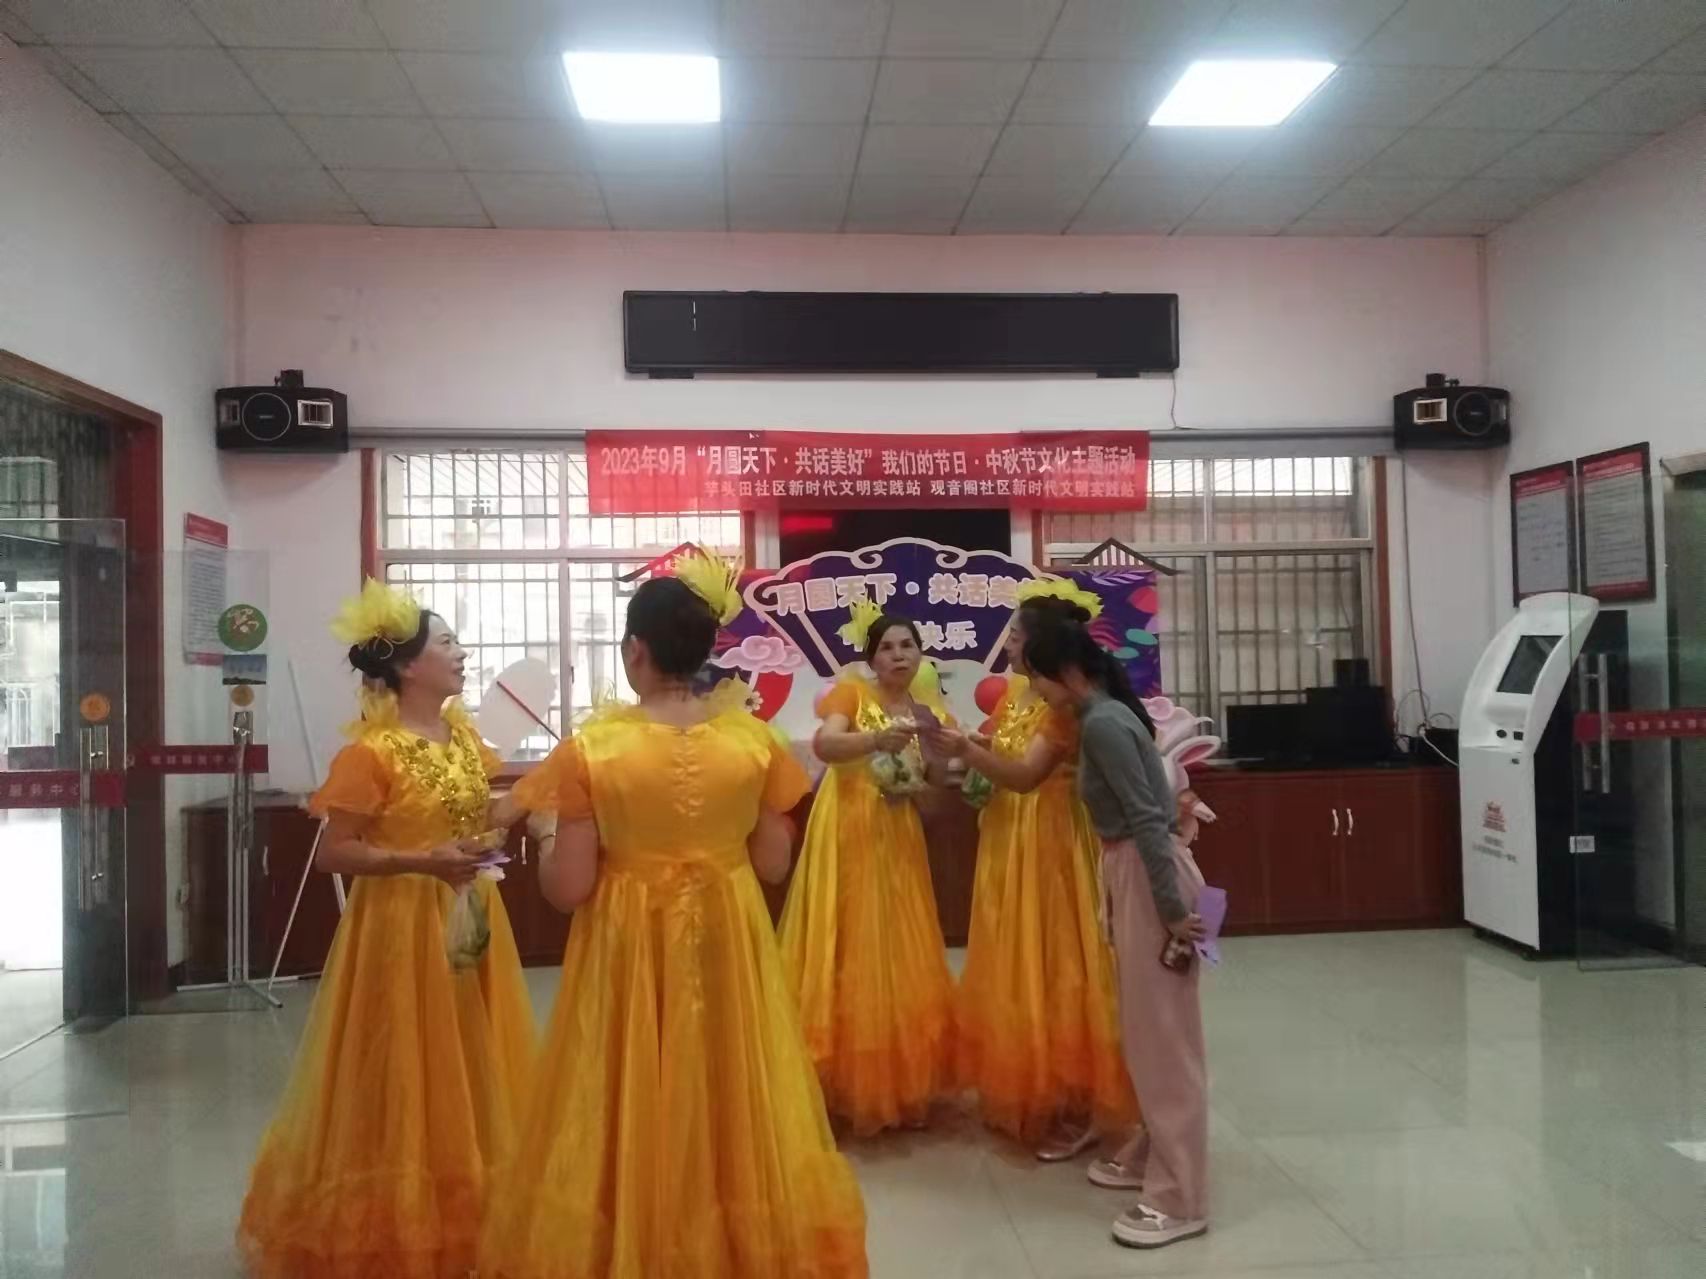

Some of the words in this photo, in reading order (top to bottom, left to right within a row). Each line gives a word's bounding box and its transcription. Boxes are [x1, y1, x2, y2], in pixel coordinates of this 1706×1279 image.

[776, 572, 1031, 616] 月圆天下·共话美
